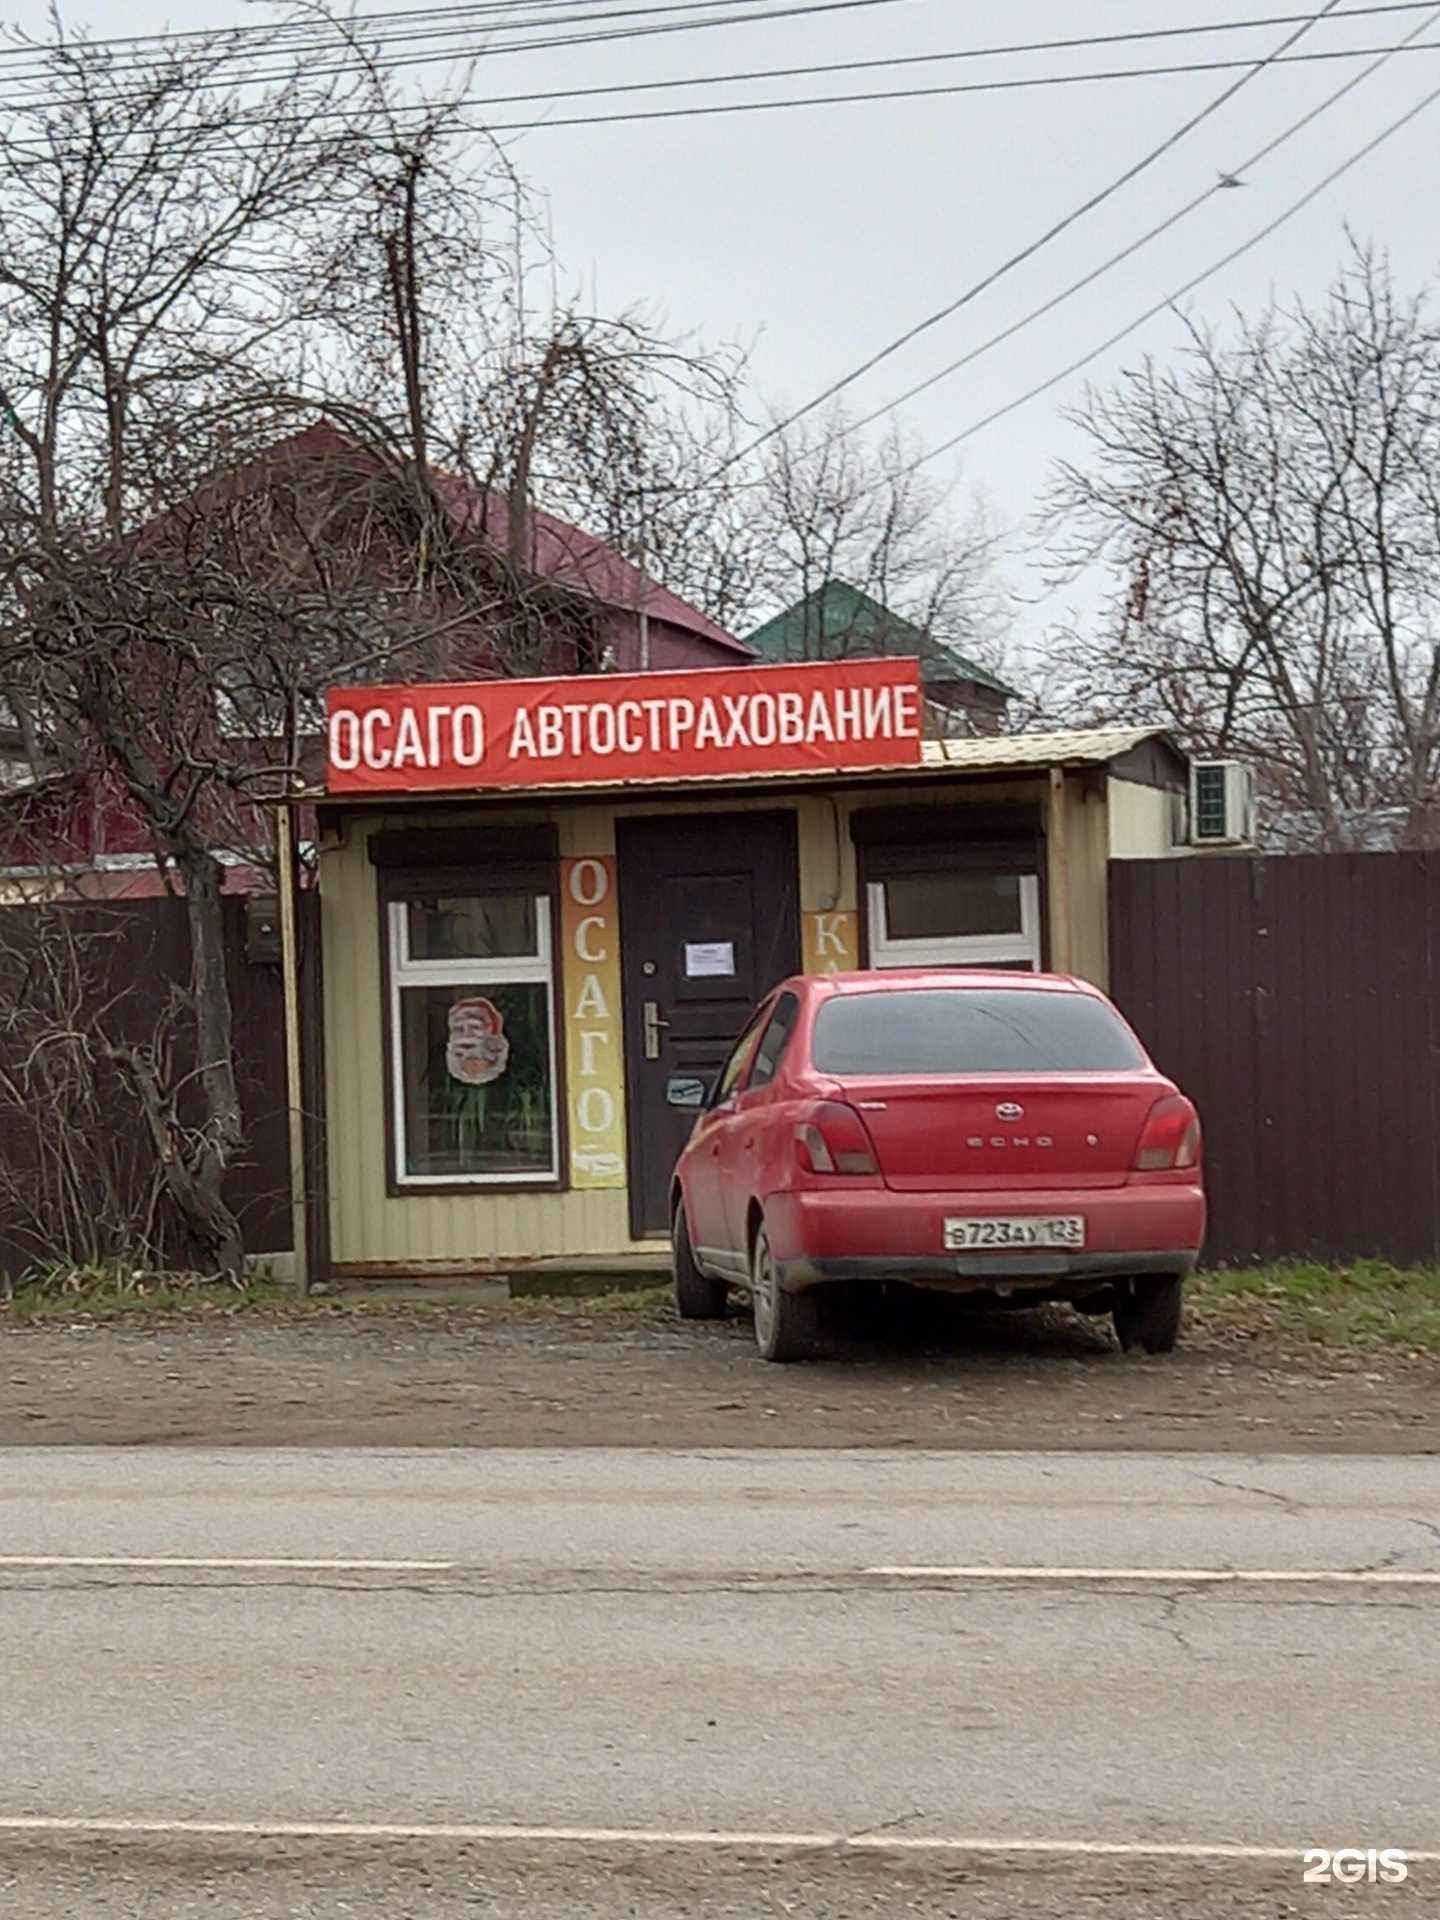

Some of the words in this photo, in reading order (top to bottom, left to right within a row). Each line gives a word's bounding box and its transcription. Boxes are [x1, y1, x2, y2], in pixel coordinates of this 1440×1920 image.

[329, 704, 484, 770] ОСАГО
[508, 685, 919, 759] АВТОСТРАХОВАНИЕ
[814, 914, 849, 974] К
[569, 859, 615, 1132] ОСАГО
